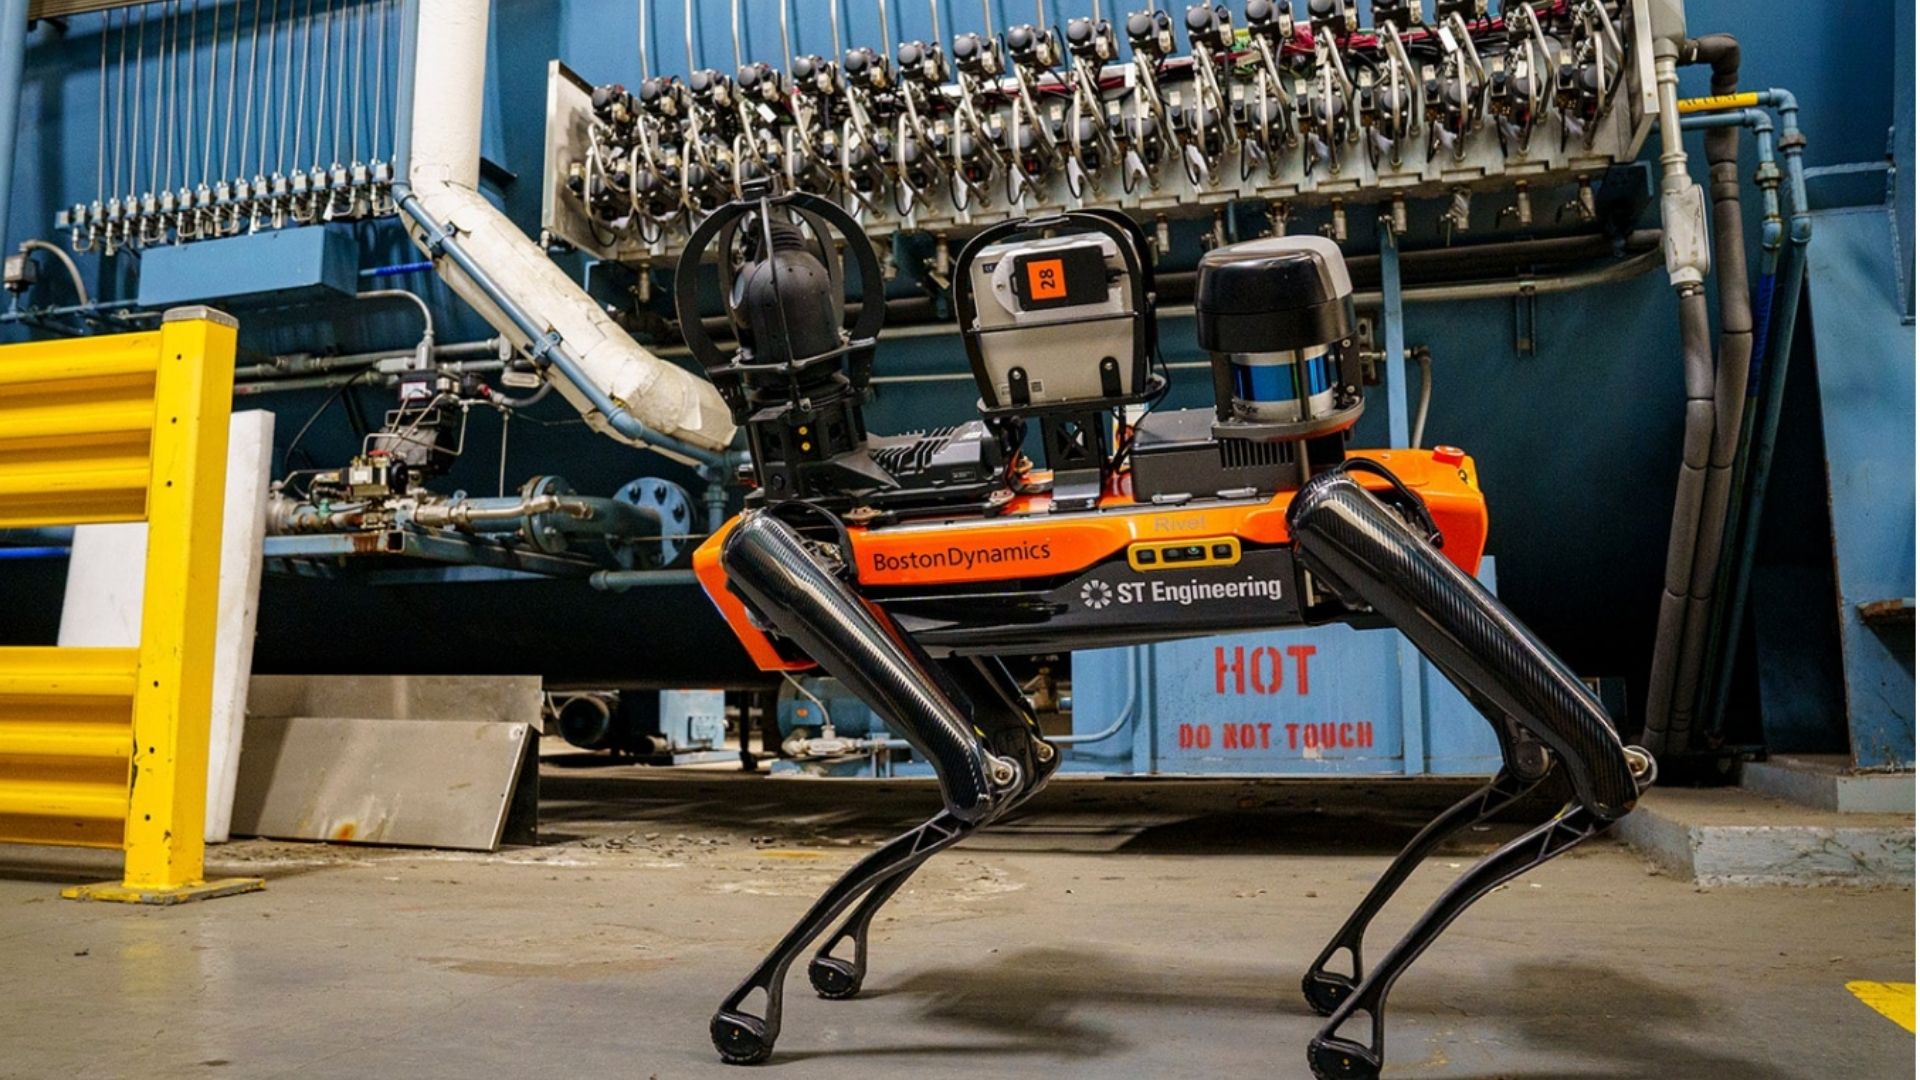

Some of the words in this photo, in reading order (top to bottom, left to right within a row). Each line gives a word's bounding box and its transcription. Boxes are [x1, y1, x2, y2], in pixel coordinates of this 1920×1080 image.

[1038, 268, 1056, 290] 28
[1117, 582, 1145, 604] ST
[1152, 576, 1282, 605] Engineering
[1214, 644, 1317, 696] HOT
[1178, 723, 1212, 750] DO
[1223, 722, 1272, 750] NOT
[1285, 721, 1374, 750] TOUCH
